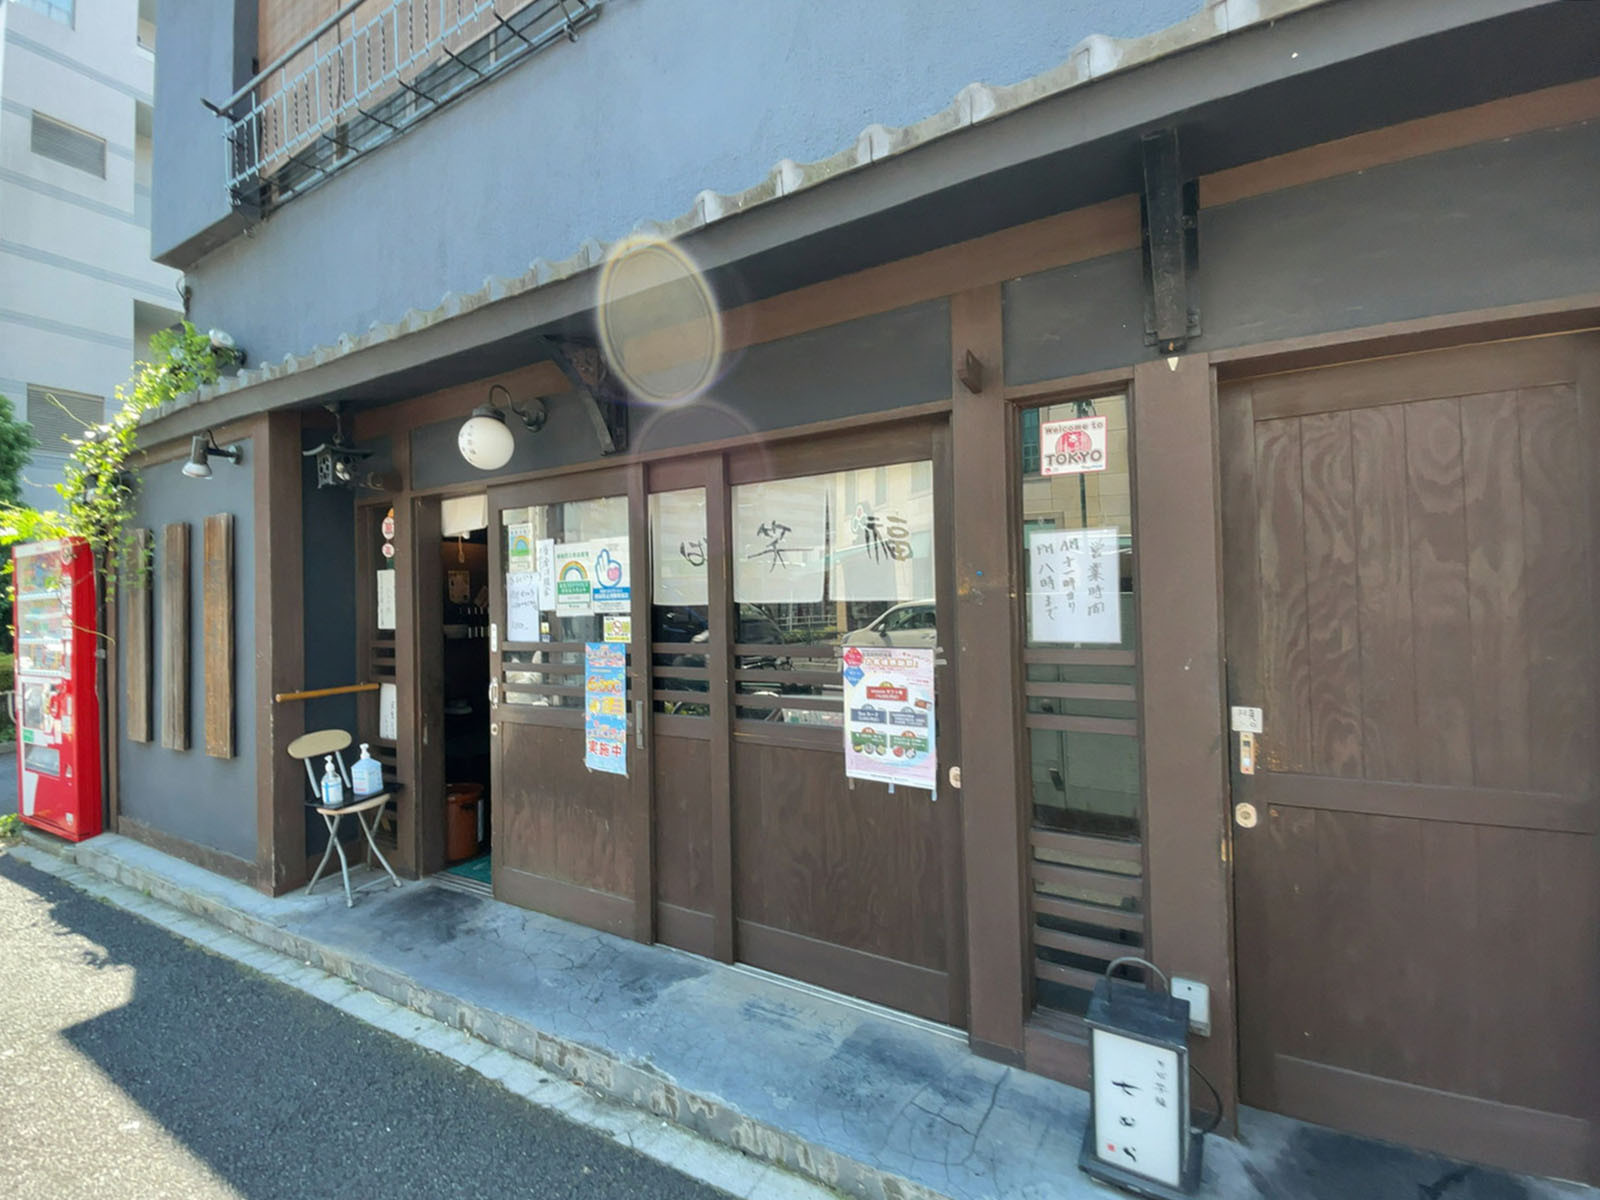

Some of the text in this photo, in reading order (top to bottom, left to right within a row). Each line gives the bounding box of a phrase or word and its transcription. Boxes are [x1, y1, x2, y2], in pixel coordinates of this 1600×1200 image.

[1045, 420, 1104, 434] Welcome to
[1045, 449, 1103, 466] TOKYO
[1087, 538, 1105, 617] 営業時間
